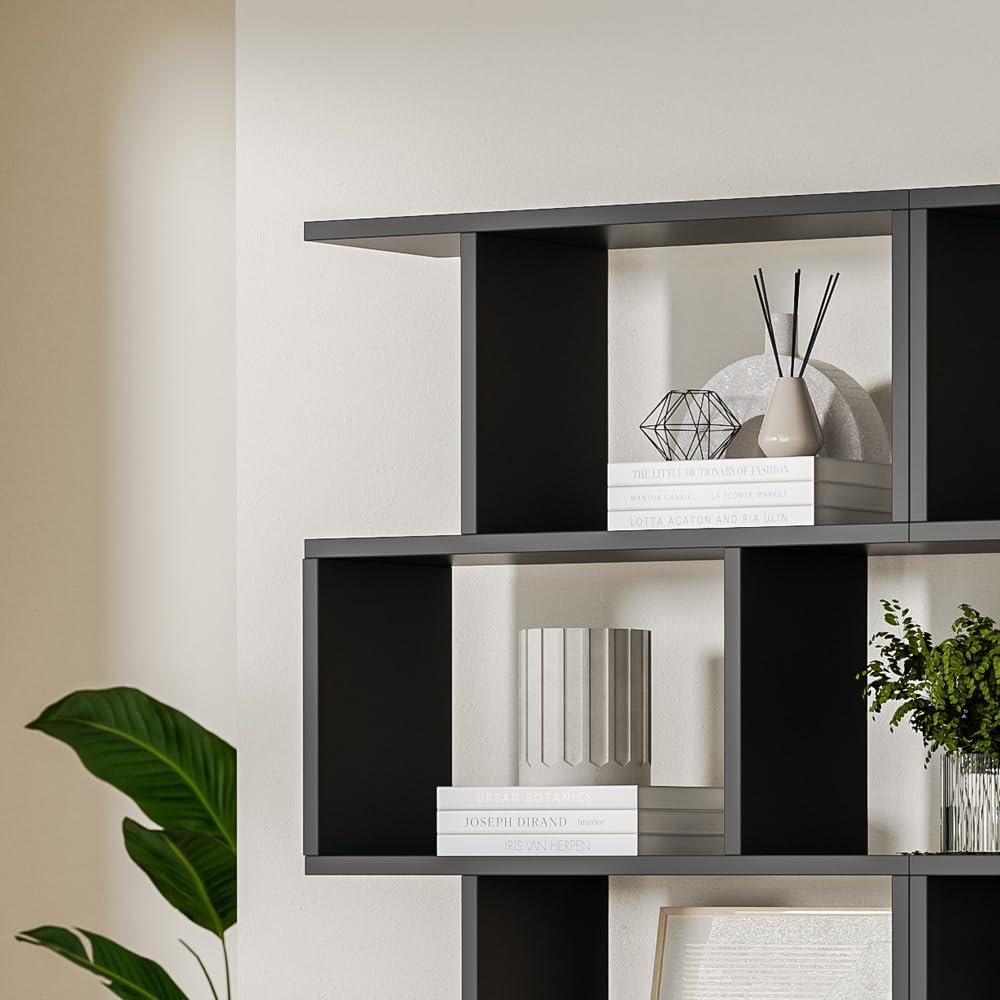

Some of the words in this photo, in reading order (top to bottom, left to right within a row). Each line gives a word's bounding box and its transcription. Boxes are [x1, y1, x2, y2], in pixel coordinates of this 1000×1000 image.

[630, 515, 664, 527] LOTTA
[667, 514, 711, 526] AGATON
[715, 514, 737, 524] AND
[741, 513, 760, 523] PIA
[763, 512, 789, 523] ULIN
[463, 817, 513, 828] JOSEPH
[517, 816, 568, 827] DIRAND
[577, 817, 605, 826] Interior
[504, 840, 522, 852] IRIS
[524, 839, 547, 852] VAN
[550, 839, 591, 852] HERPEN
